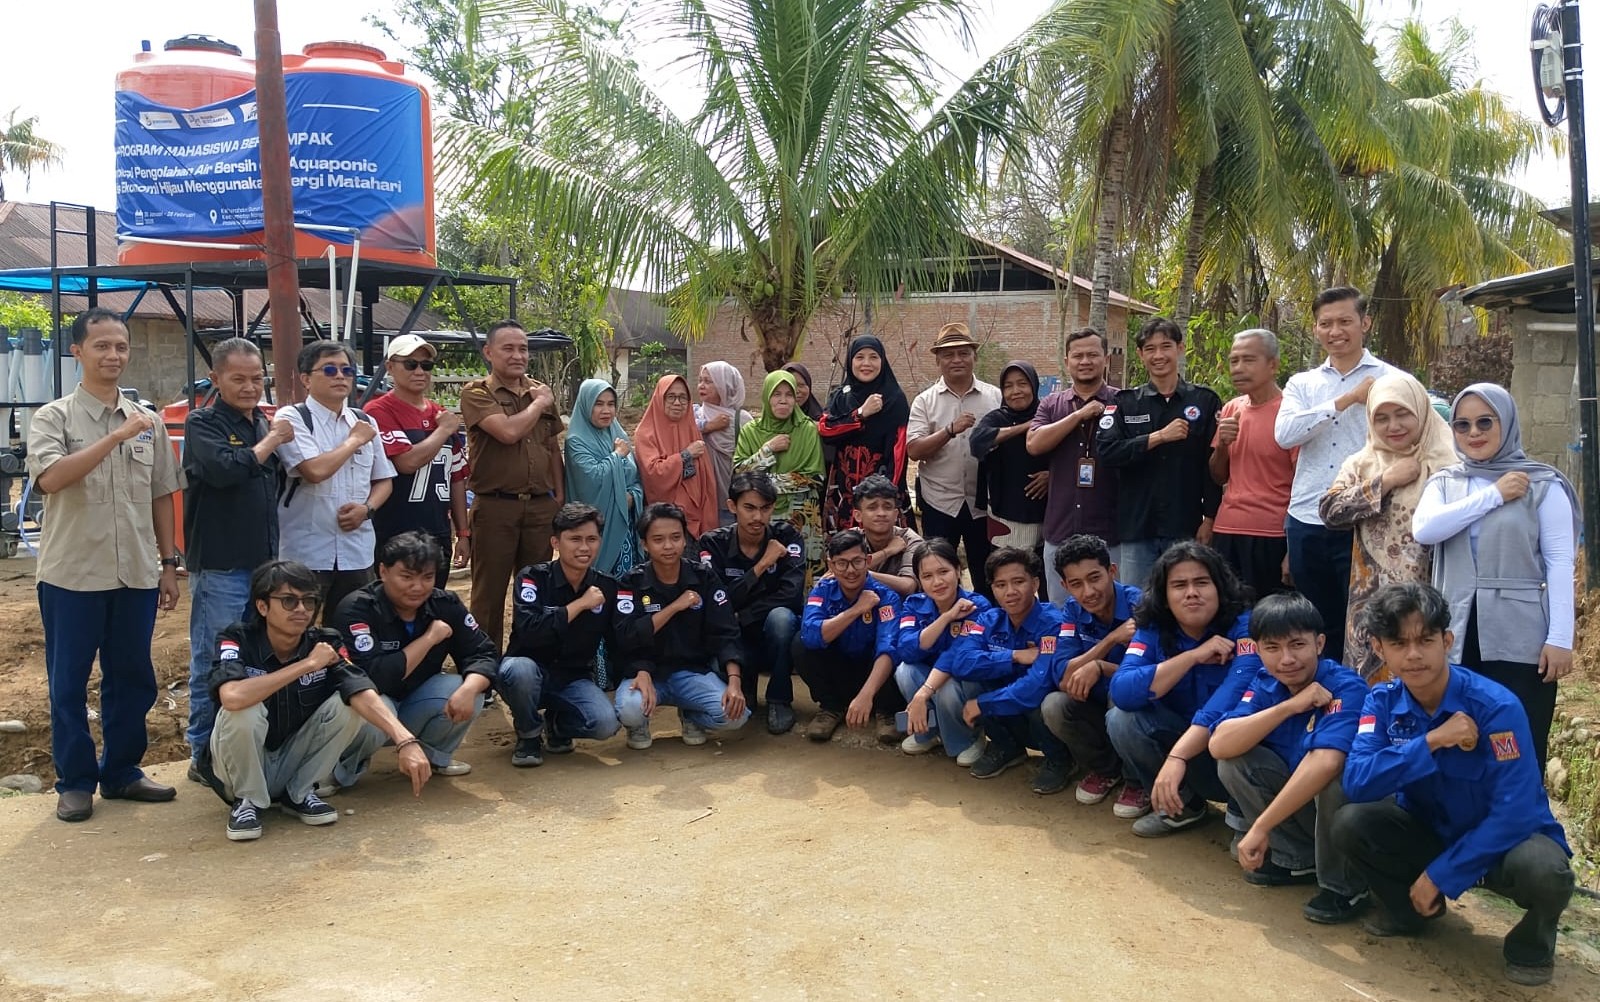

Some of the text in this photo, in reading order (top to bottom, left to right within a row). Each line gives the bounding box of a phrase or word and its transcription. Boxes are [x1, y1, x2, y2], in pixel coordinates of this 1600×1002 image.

[163, 140, 239, 157] MAHASISWA
[134, 165, 194, 181] Pengolahan
[194, 163, 213, 176] Air
[214, 159, 257, 175] Bersih
[289, 156, 378, 173] Aquaponic
[184, 176, 262, 195] Menggunaka
[291, 174, 324, 190] ergi
[327, 173, 402, 193] Matahari
[1494, 737, 1516, 756] M
